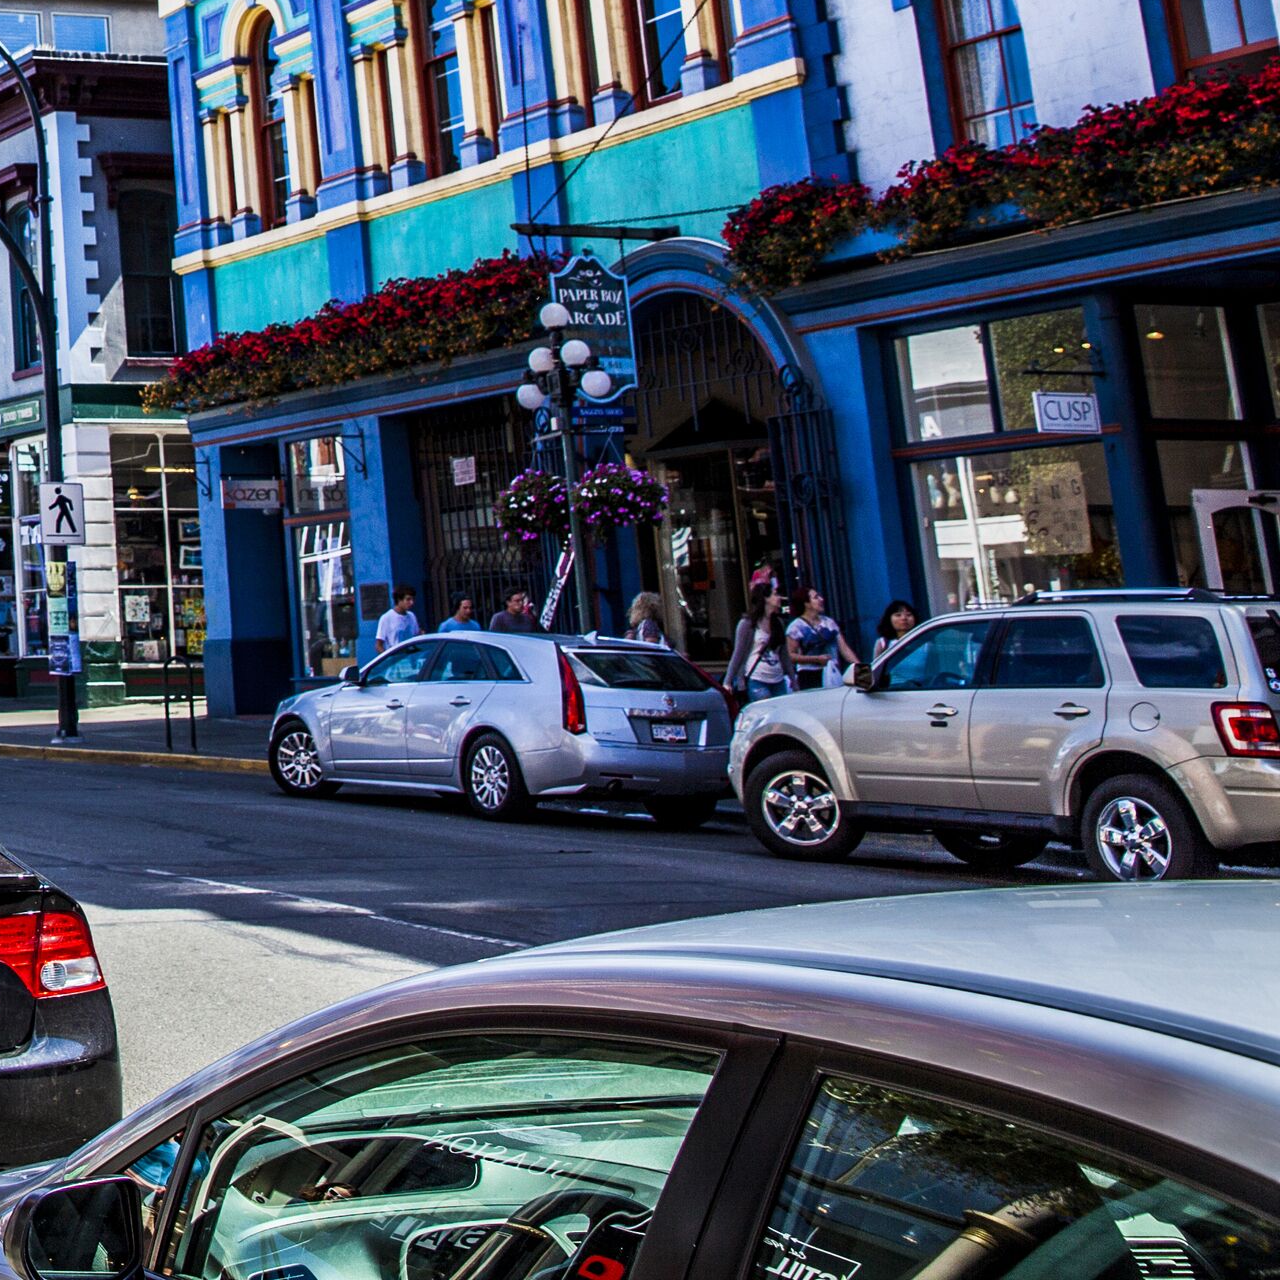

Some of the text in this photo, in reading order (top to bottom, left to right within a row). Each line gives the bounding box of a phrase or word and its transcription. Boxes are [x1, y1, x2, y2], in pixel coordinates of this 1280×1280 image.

[558, 288, 600, 304] PAPER
[1044, 400, 1090, 421] CUSP
[225, 487, 278, 502] kazen
